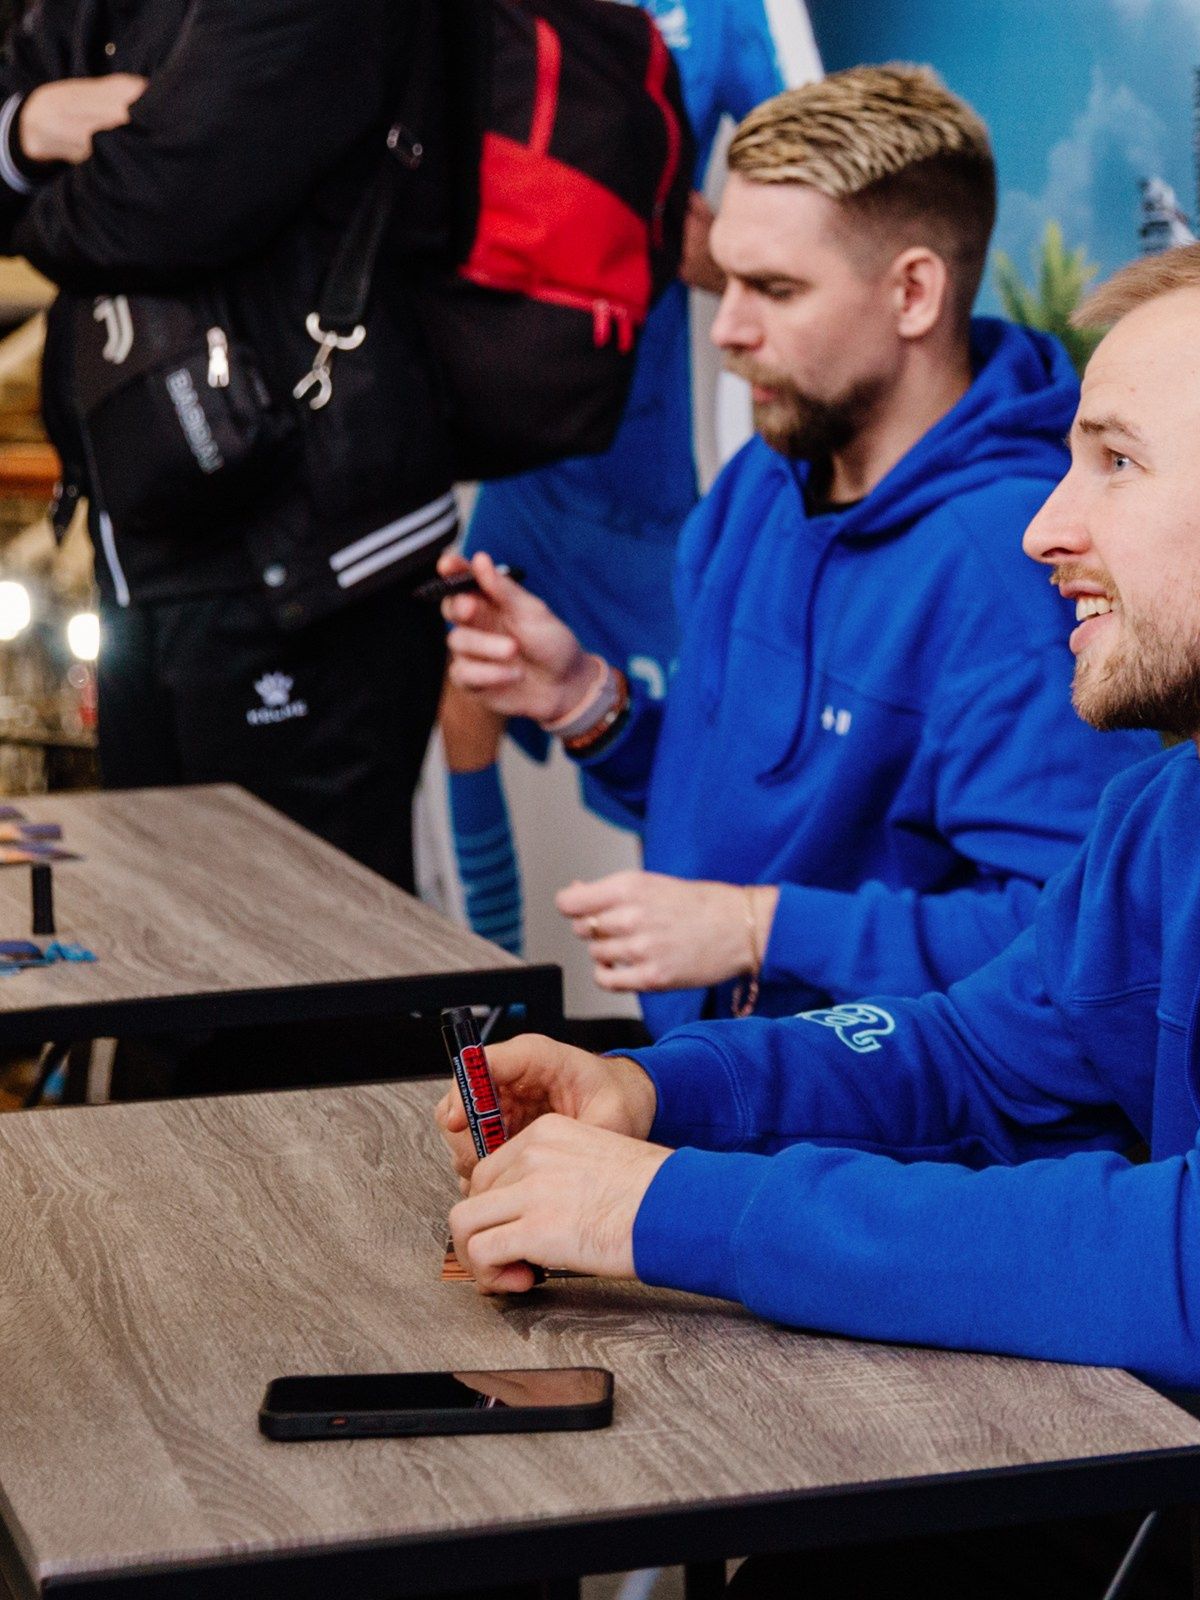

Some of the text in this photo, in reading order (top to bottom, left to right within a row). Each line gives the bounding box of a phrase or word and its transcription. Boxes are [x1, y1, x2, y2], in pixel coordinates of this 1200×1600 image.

[452, 1055, 485, 1159] АРКЕР ПЕРМАНЕНТНЫЙ
[460, 1044, 507, 1156] ULTI MARKER
